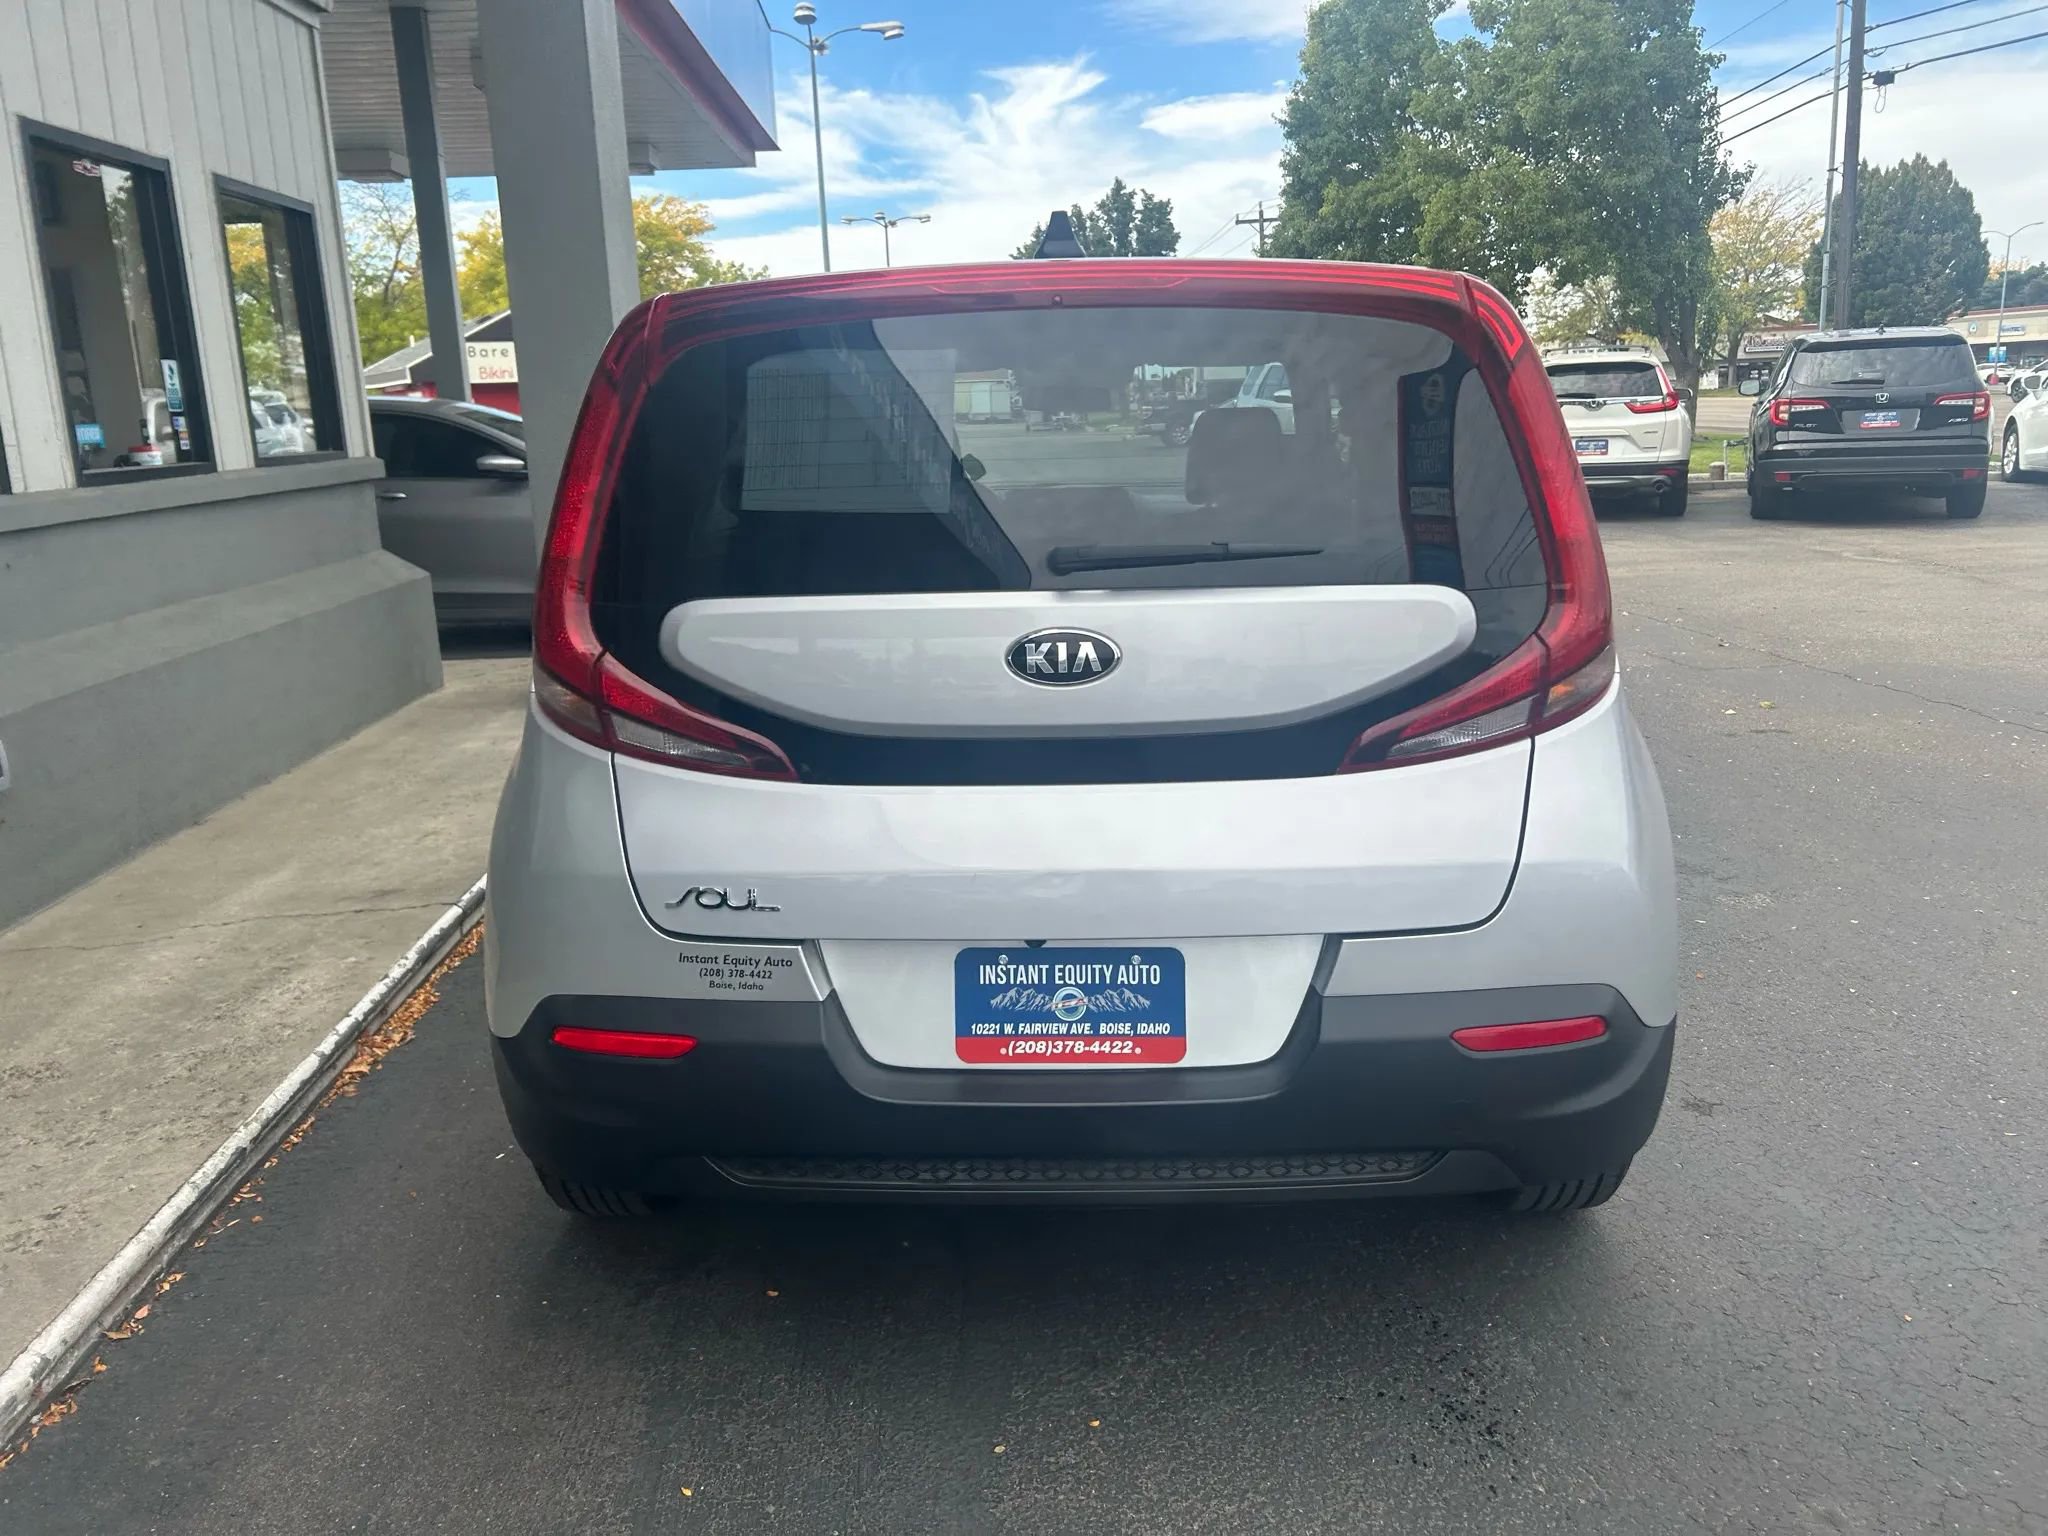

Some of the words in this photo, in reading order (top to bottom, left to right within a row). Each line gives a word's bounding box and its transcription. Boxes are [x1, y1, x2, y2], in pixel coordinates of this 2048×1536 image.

[467, 346, 509, 358] Bare
[1025, 641, 1102, 674] KIA
[678, 952, 719, 965] Instant
[723, 954, 761, 969] Equity
[764, 956, 793, 967] Auto
[699, 967, 725, 980] (208)
[727, 968, 773, 980] 378-4422
[979, 963, 1049, 985] INSTANT
[1054, 964, 1113, 986] EQUITY
[1117, 964, 1161, 985] AUTO
[708, 980, 736, 991] Boise,
[738, 981, 764, 991] Idaho
[971, 1023, 1001, 1035] 10221
[1003, 1023, 1014, 1035] W.
[1018, 1023, 1067, 1035] FAIRVIEW
[1069, 1023, 1093, 1035] AVE.
[1099, 1023, 1134, 1037] BOISE,
[1136, 1023, 1171, 1035] IDAHO
[1007, 1040, 1134, 1056] (208)378-4422
